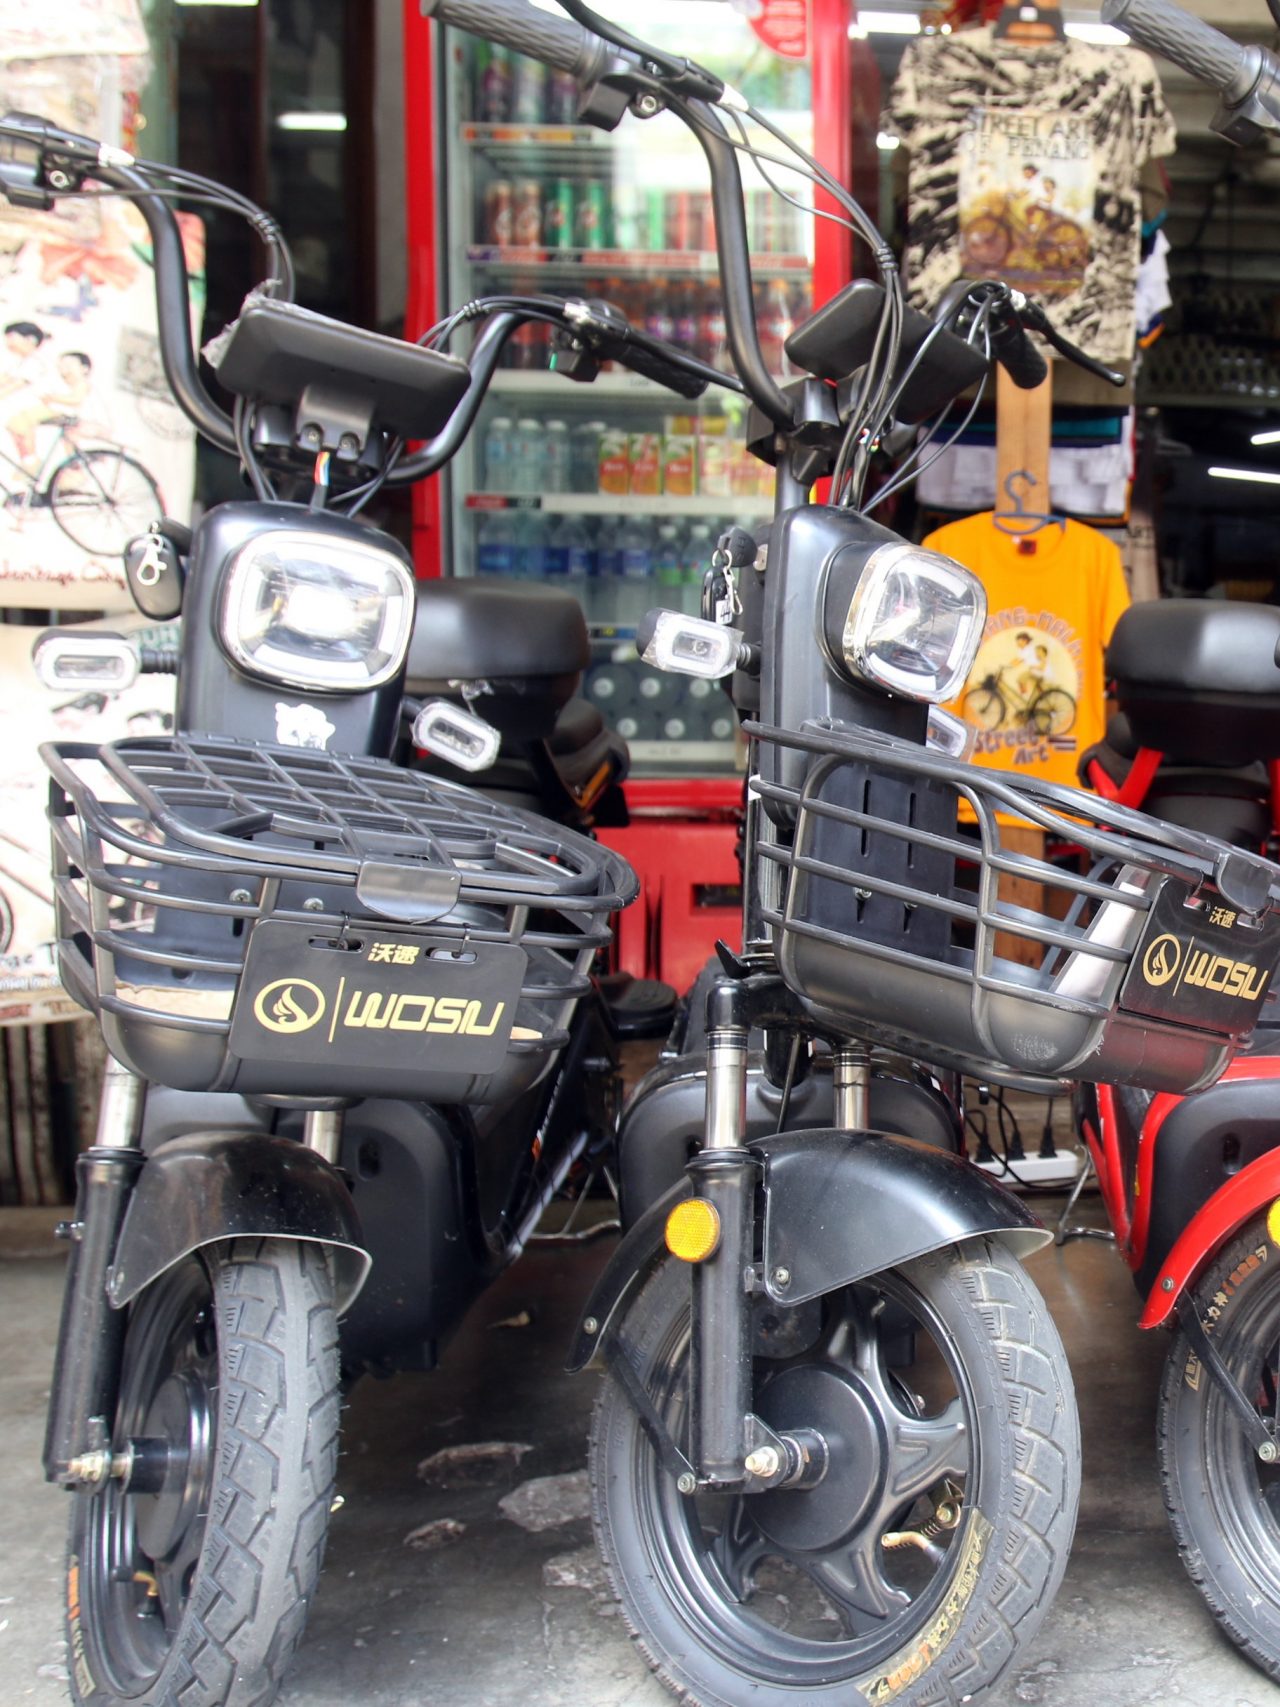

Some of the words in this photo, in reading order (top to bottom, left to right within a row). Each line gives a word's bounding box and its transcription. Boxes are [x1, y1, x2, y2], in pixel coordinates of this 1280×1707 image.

[967, 109, 1038, 137] STREET
[1050, 116, 1094, 139] ART
[1008, 135, 1090, 159] PENANG
[1209, 905, 1236, 929] 沃速
[367, 942, 420, 965] 沃速
[1183, 950, 1269, 1001] WOSU
[343, 990, 505, 1036] WOSU
